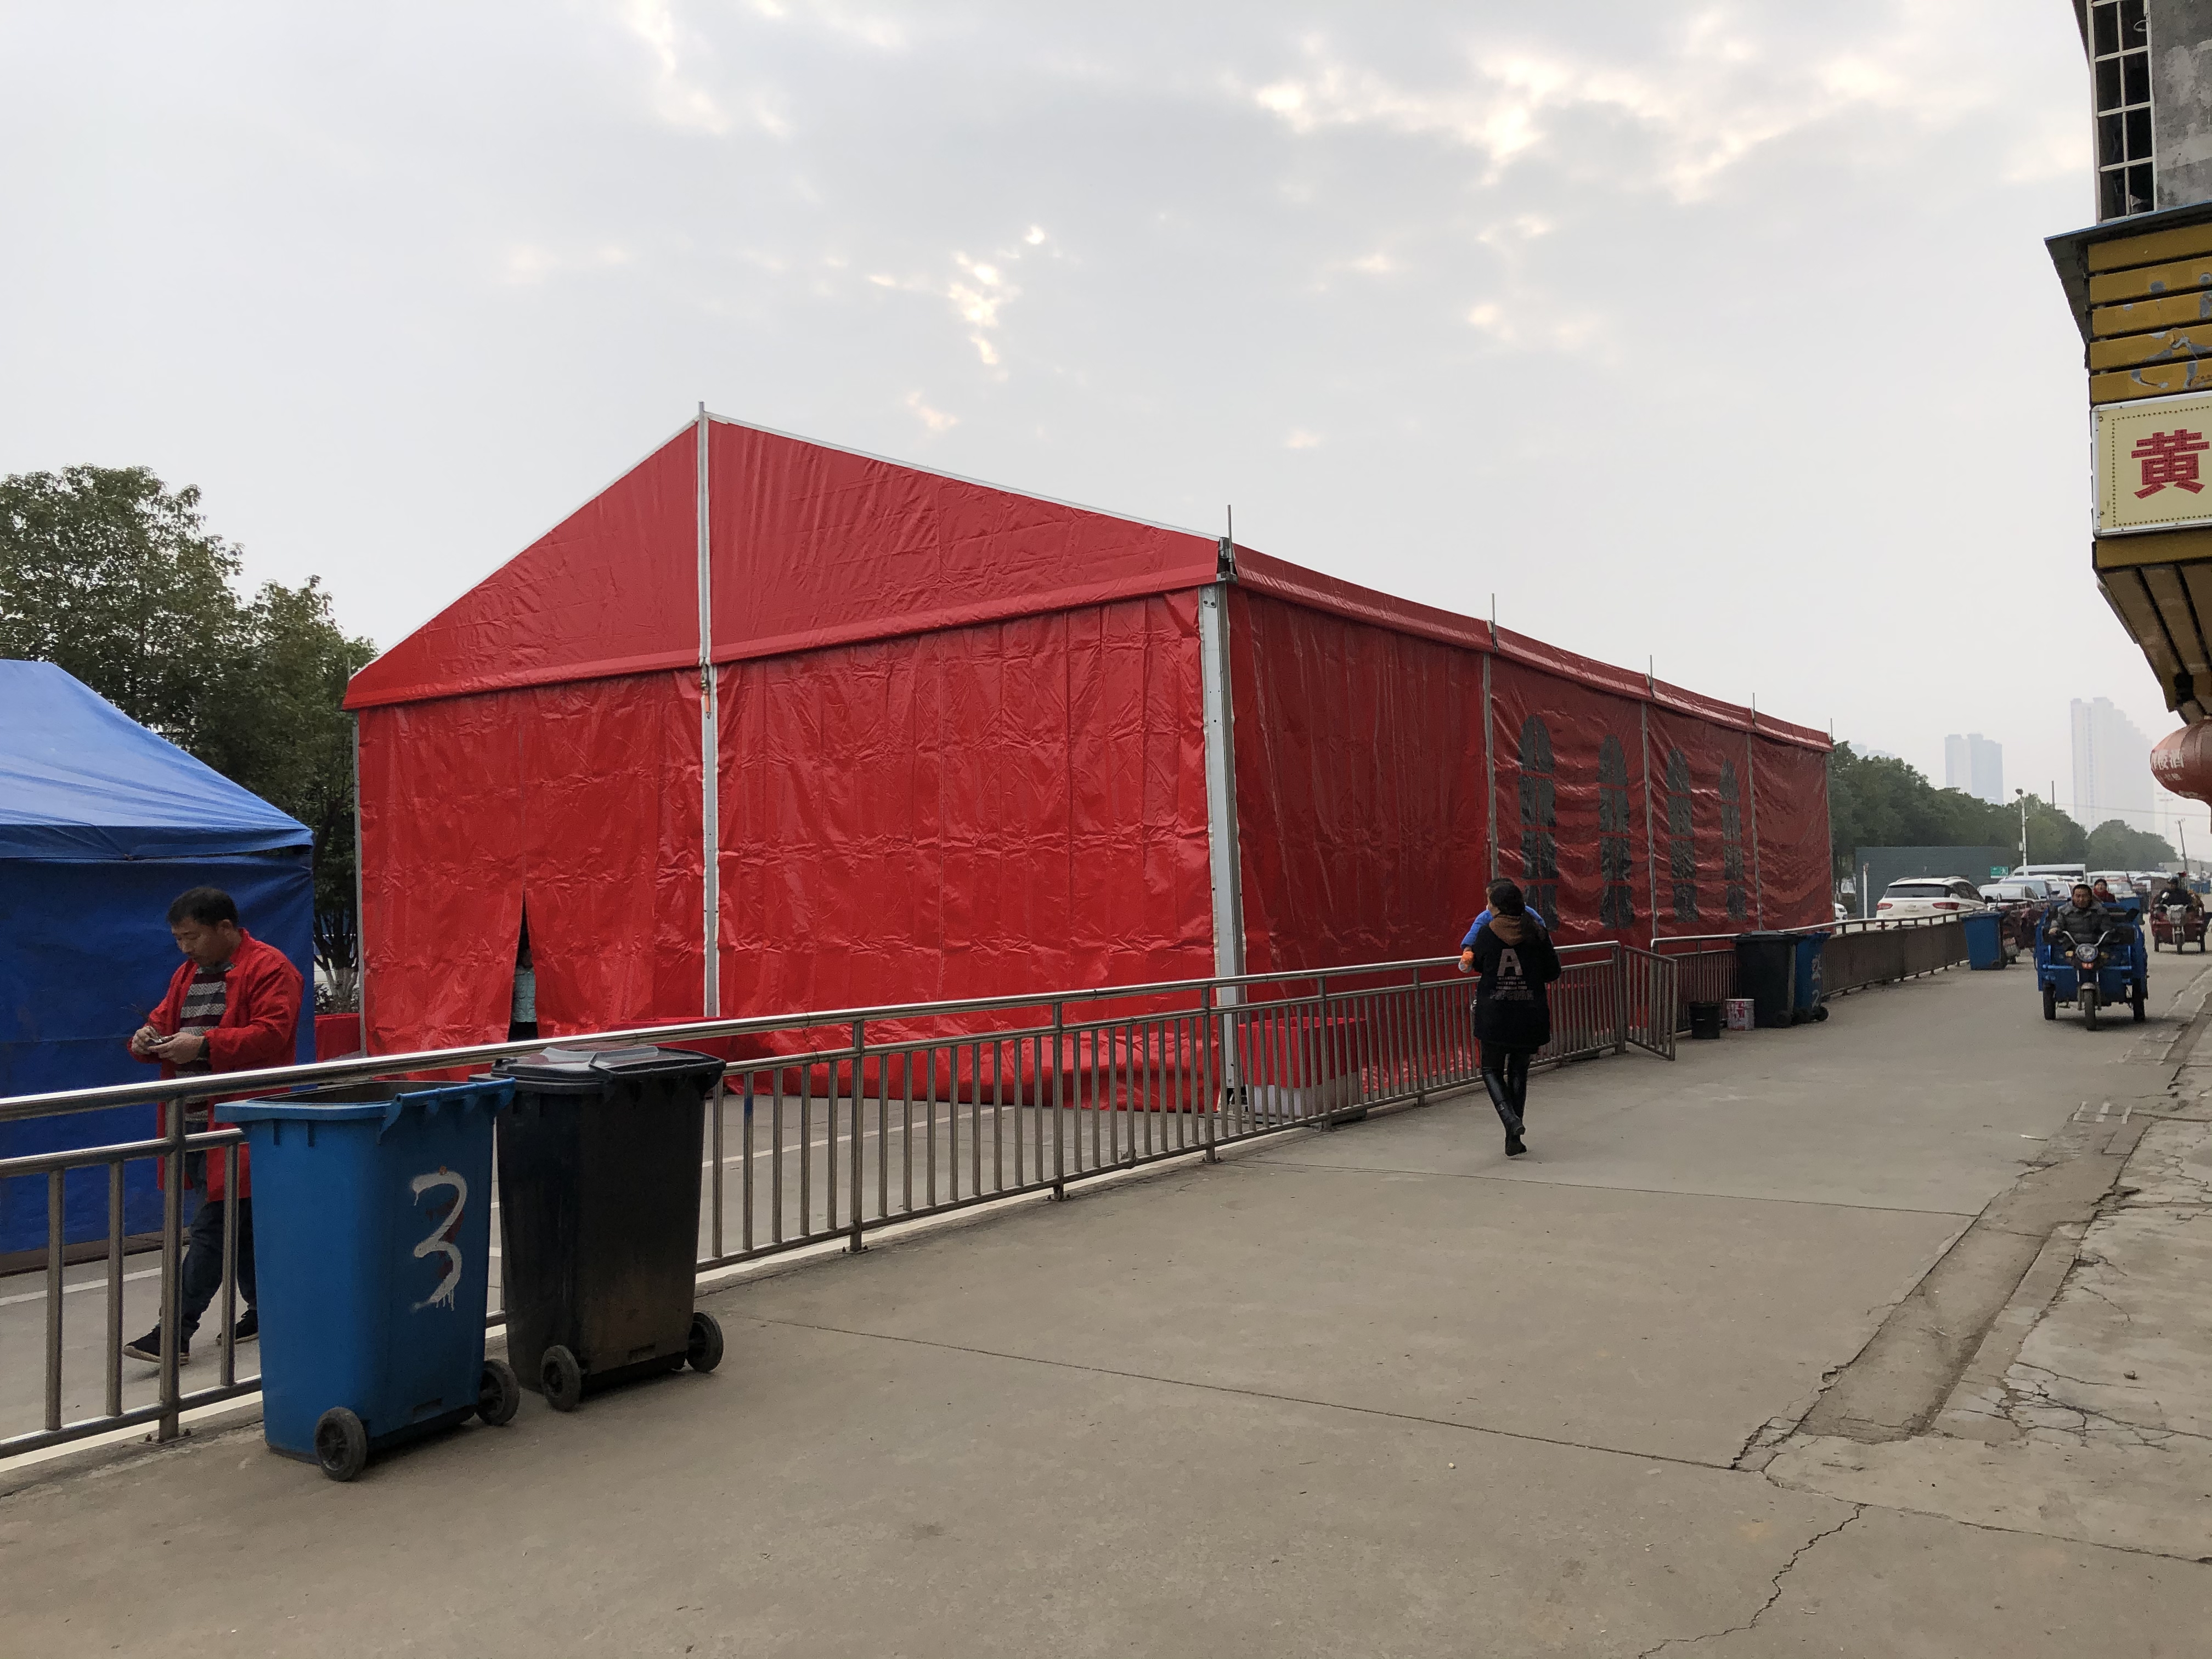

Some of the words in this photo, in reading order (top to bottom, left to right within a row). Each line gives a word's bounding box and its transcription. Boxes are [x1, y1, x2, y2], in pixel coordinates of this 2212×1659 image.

[2131, 429, 2210, 499] 黄
[1497, 949, 1523, 977] A
[411, 1171, 467, 1311] 3
